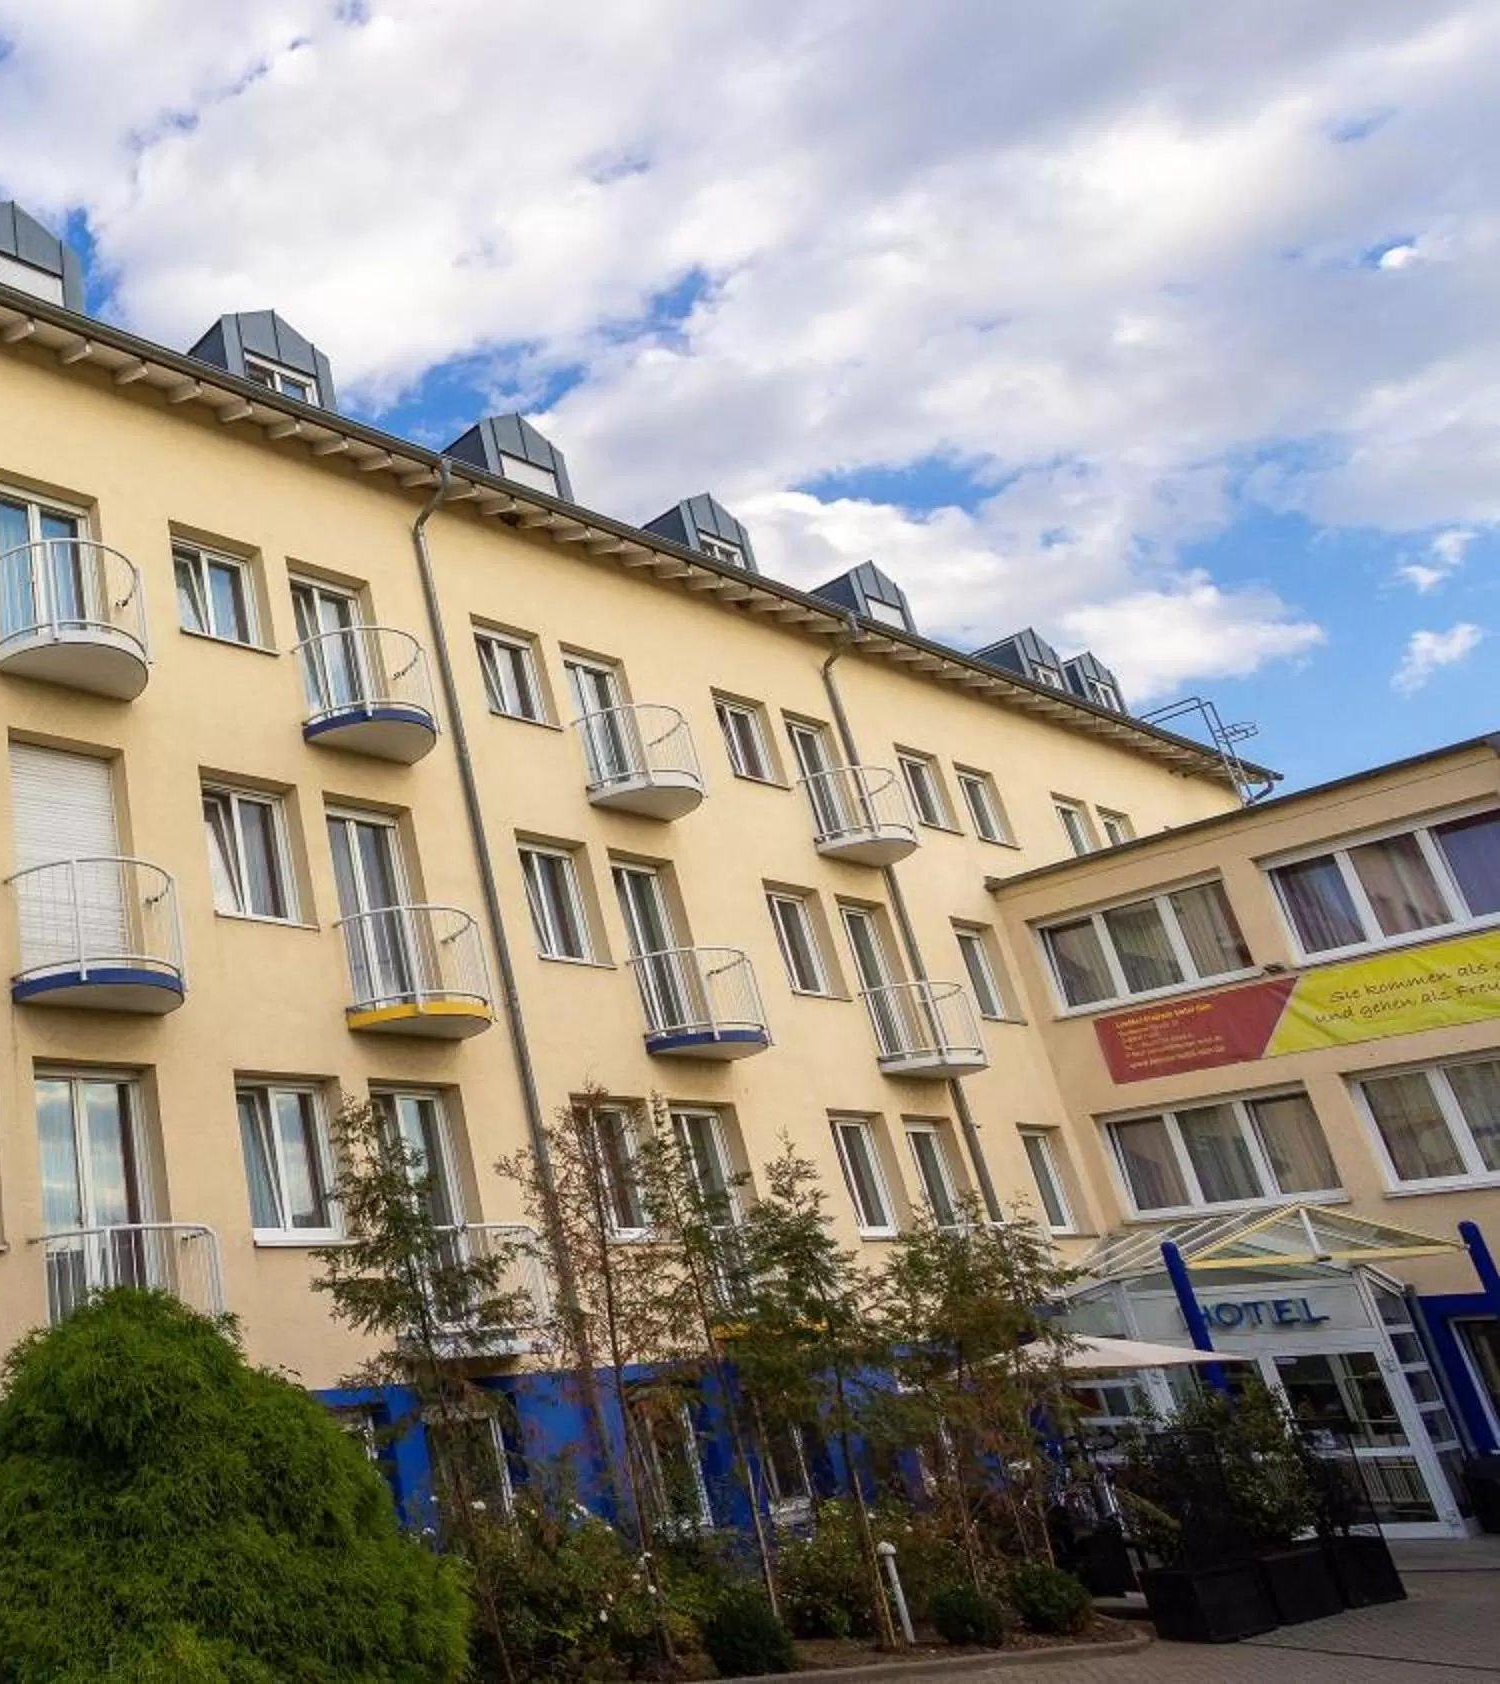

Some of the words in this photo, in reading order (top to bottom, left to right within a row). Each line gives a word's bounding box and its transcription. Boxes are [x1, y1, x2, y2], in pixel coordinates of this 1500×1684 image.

[1330, 989, 1361, 1004] Sie
[1363, 971, 1452, 995] kommen
[1457, 962, 1489, 978] als
[1315, 1005, 1354, 1022] und
[1360, 998, 1418, 1019] gehen
[1421, 990, 1453, 1004] als
